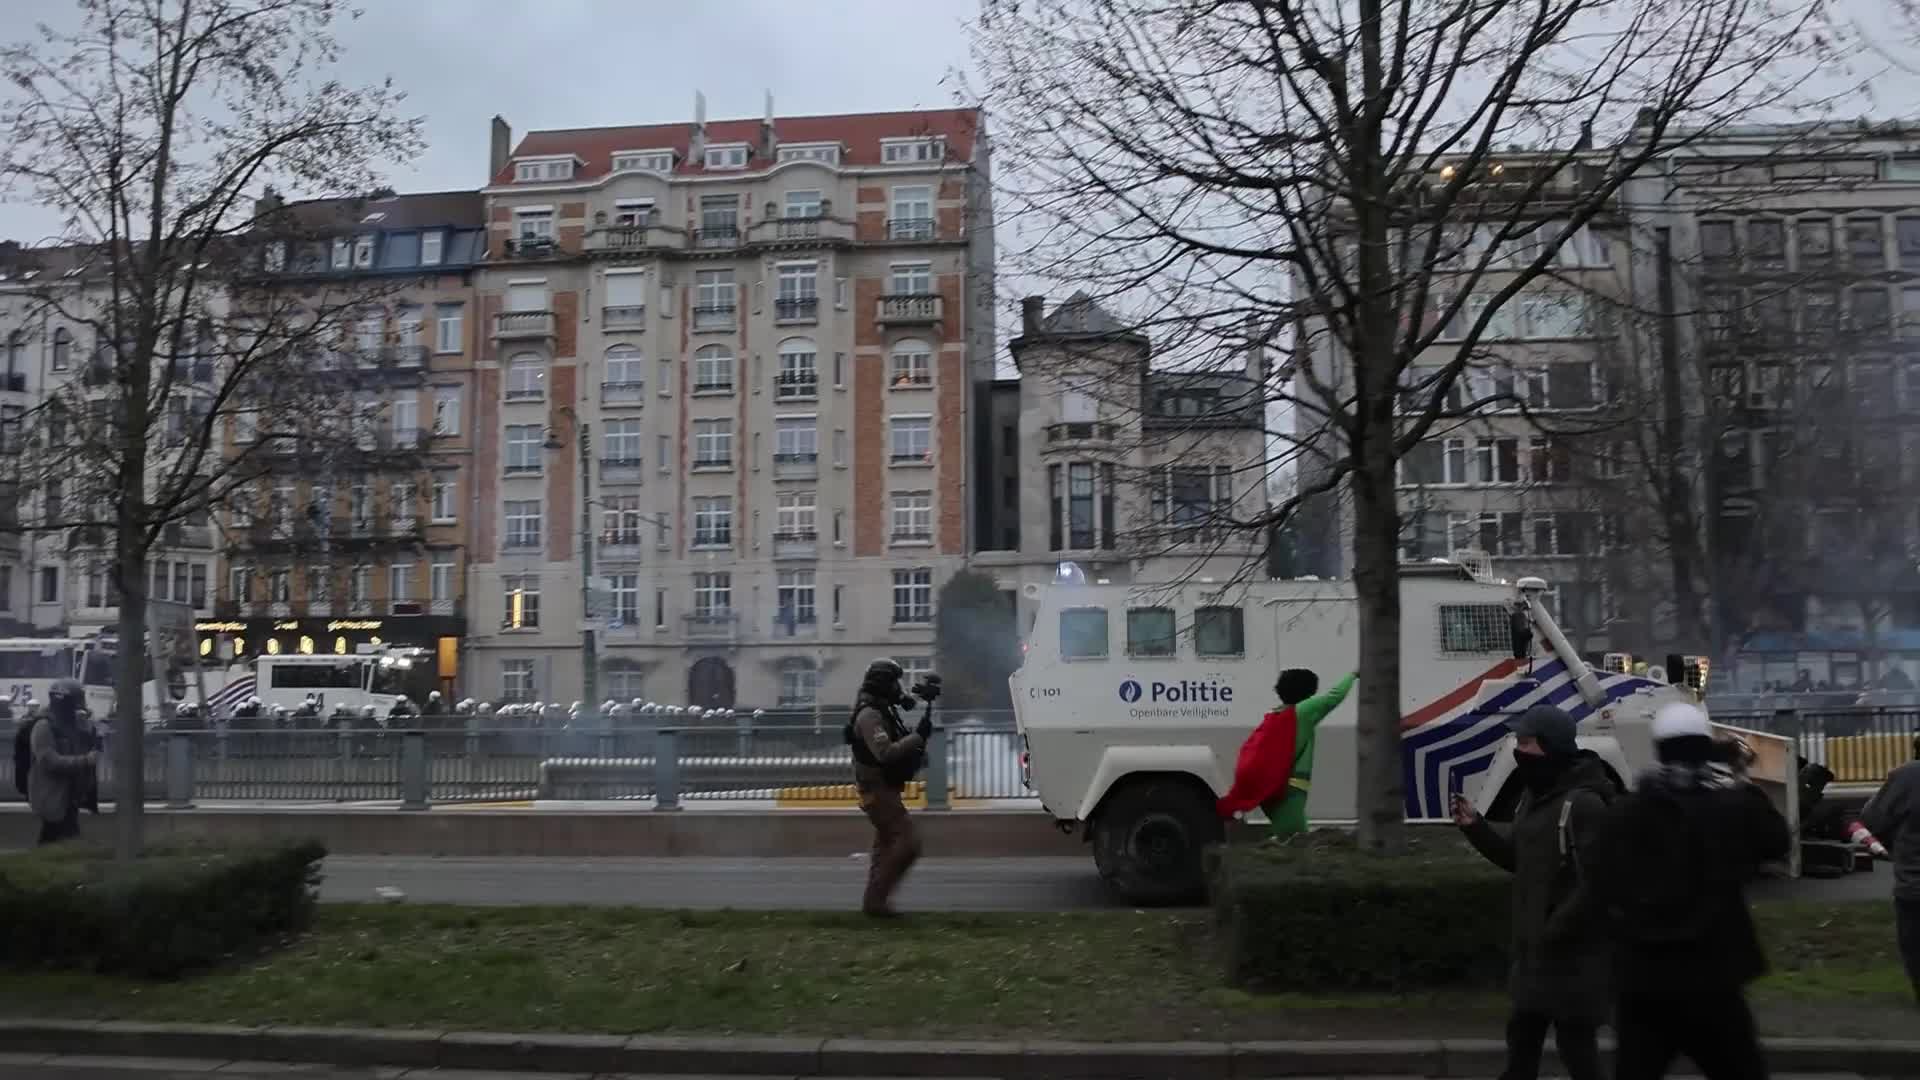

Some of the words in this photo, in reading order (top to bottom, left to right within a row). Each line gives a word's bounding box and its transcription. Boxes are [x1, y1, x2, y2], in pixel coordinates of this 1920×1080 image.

[1041, 687, 1061, 697] 101
[1152, 681, 1232, 702] Politie
[1129, 708, 1179, 720] Openbare
[1180, 707, 1229, 719] Veiligheid
